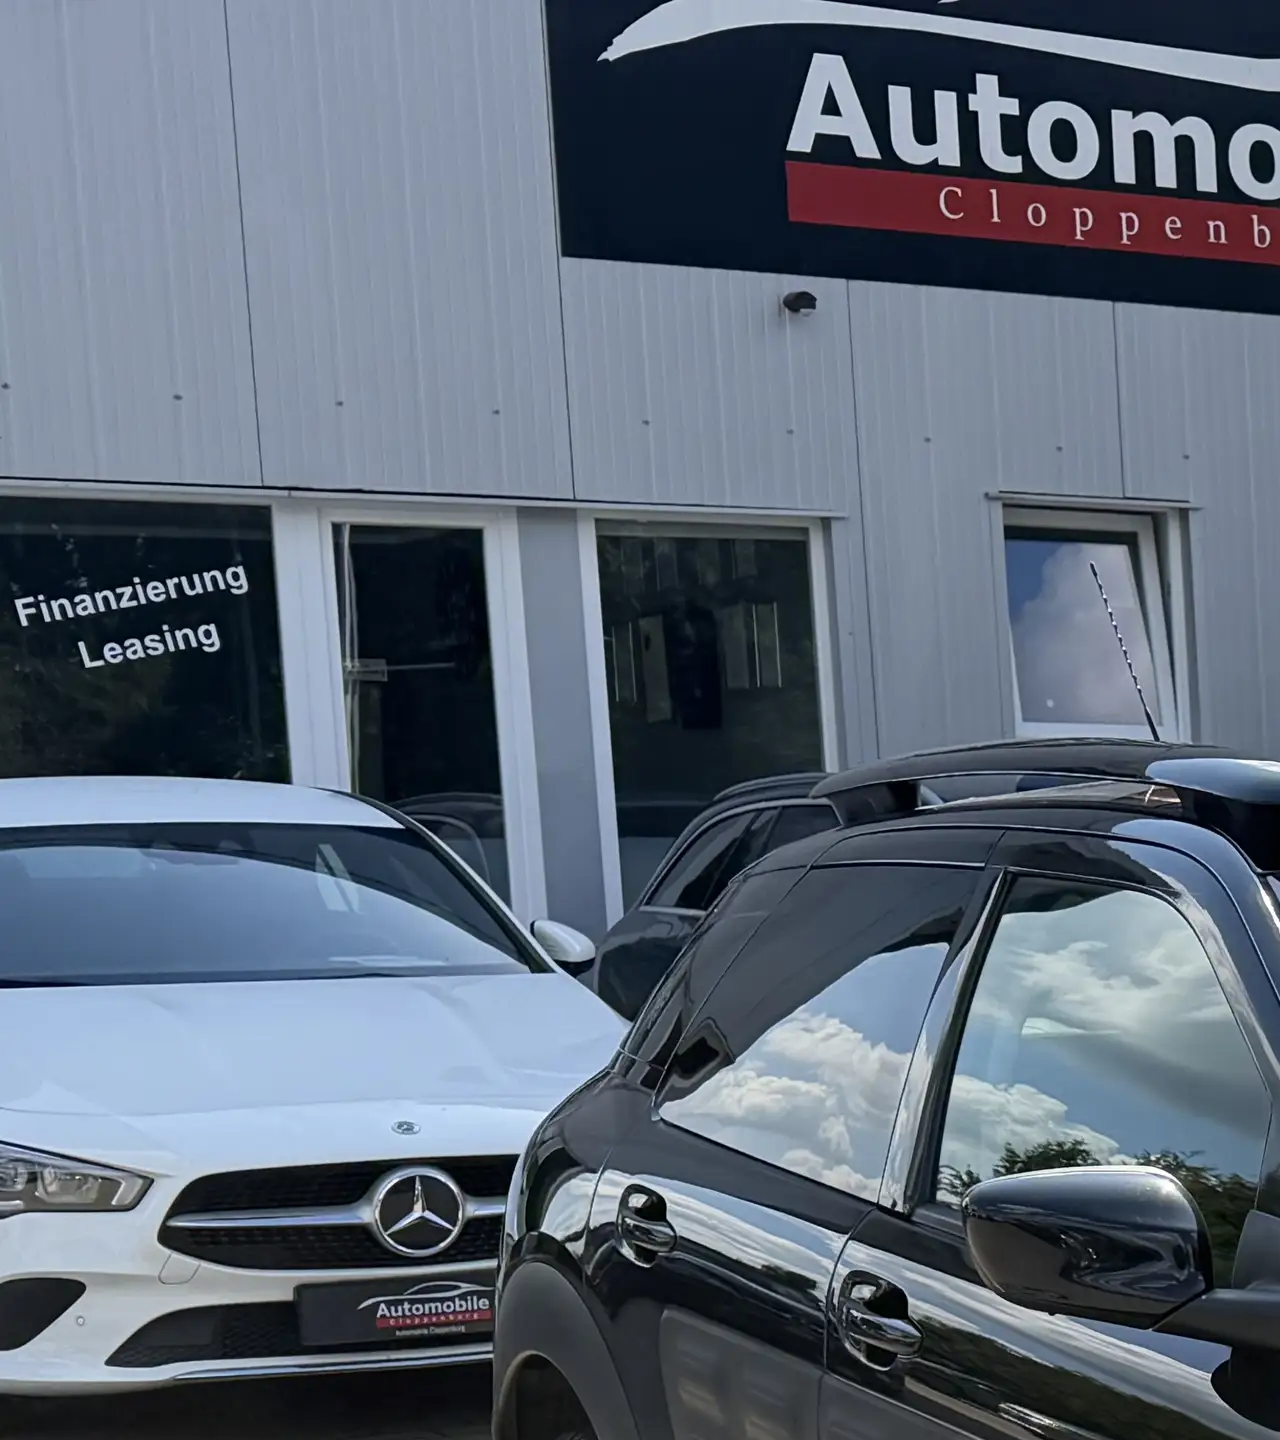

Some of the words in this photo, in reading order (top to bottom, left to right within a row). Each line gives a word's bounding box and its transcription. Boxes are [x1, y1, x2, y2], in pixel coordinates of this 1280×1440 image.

[14, 565, 249, 627] Finanzierung
[77, 622, 221, 669] Leasing
[376, 1295, 490, 1319] Automobile
